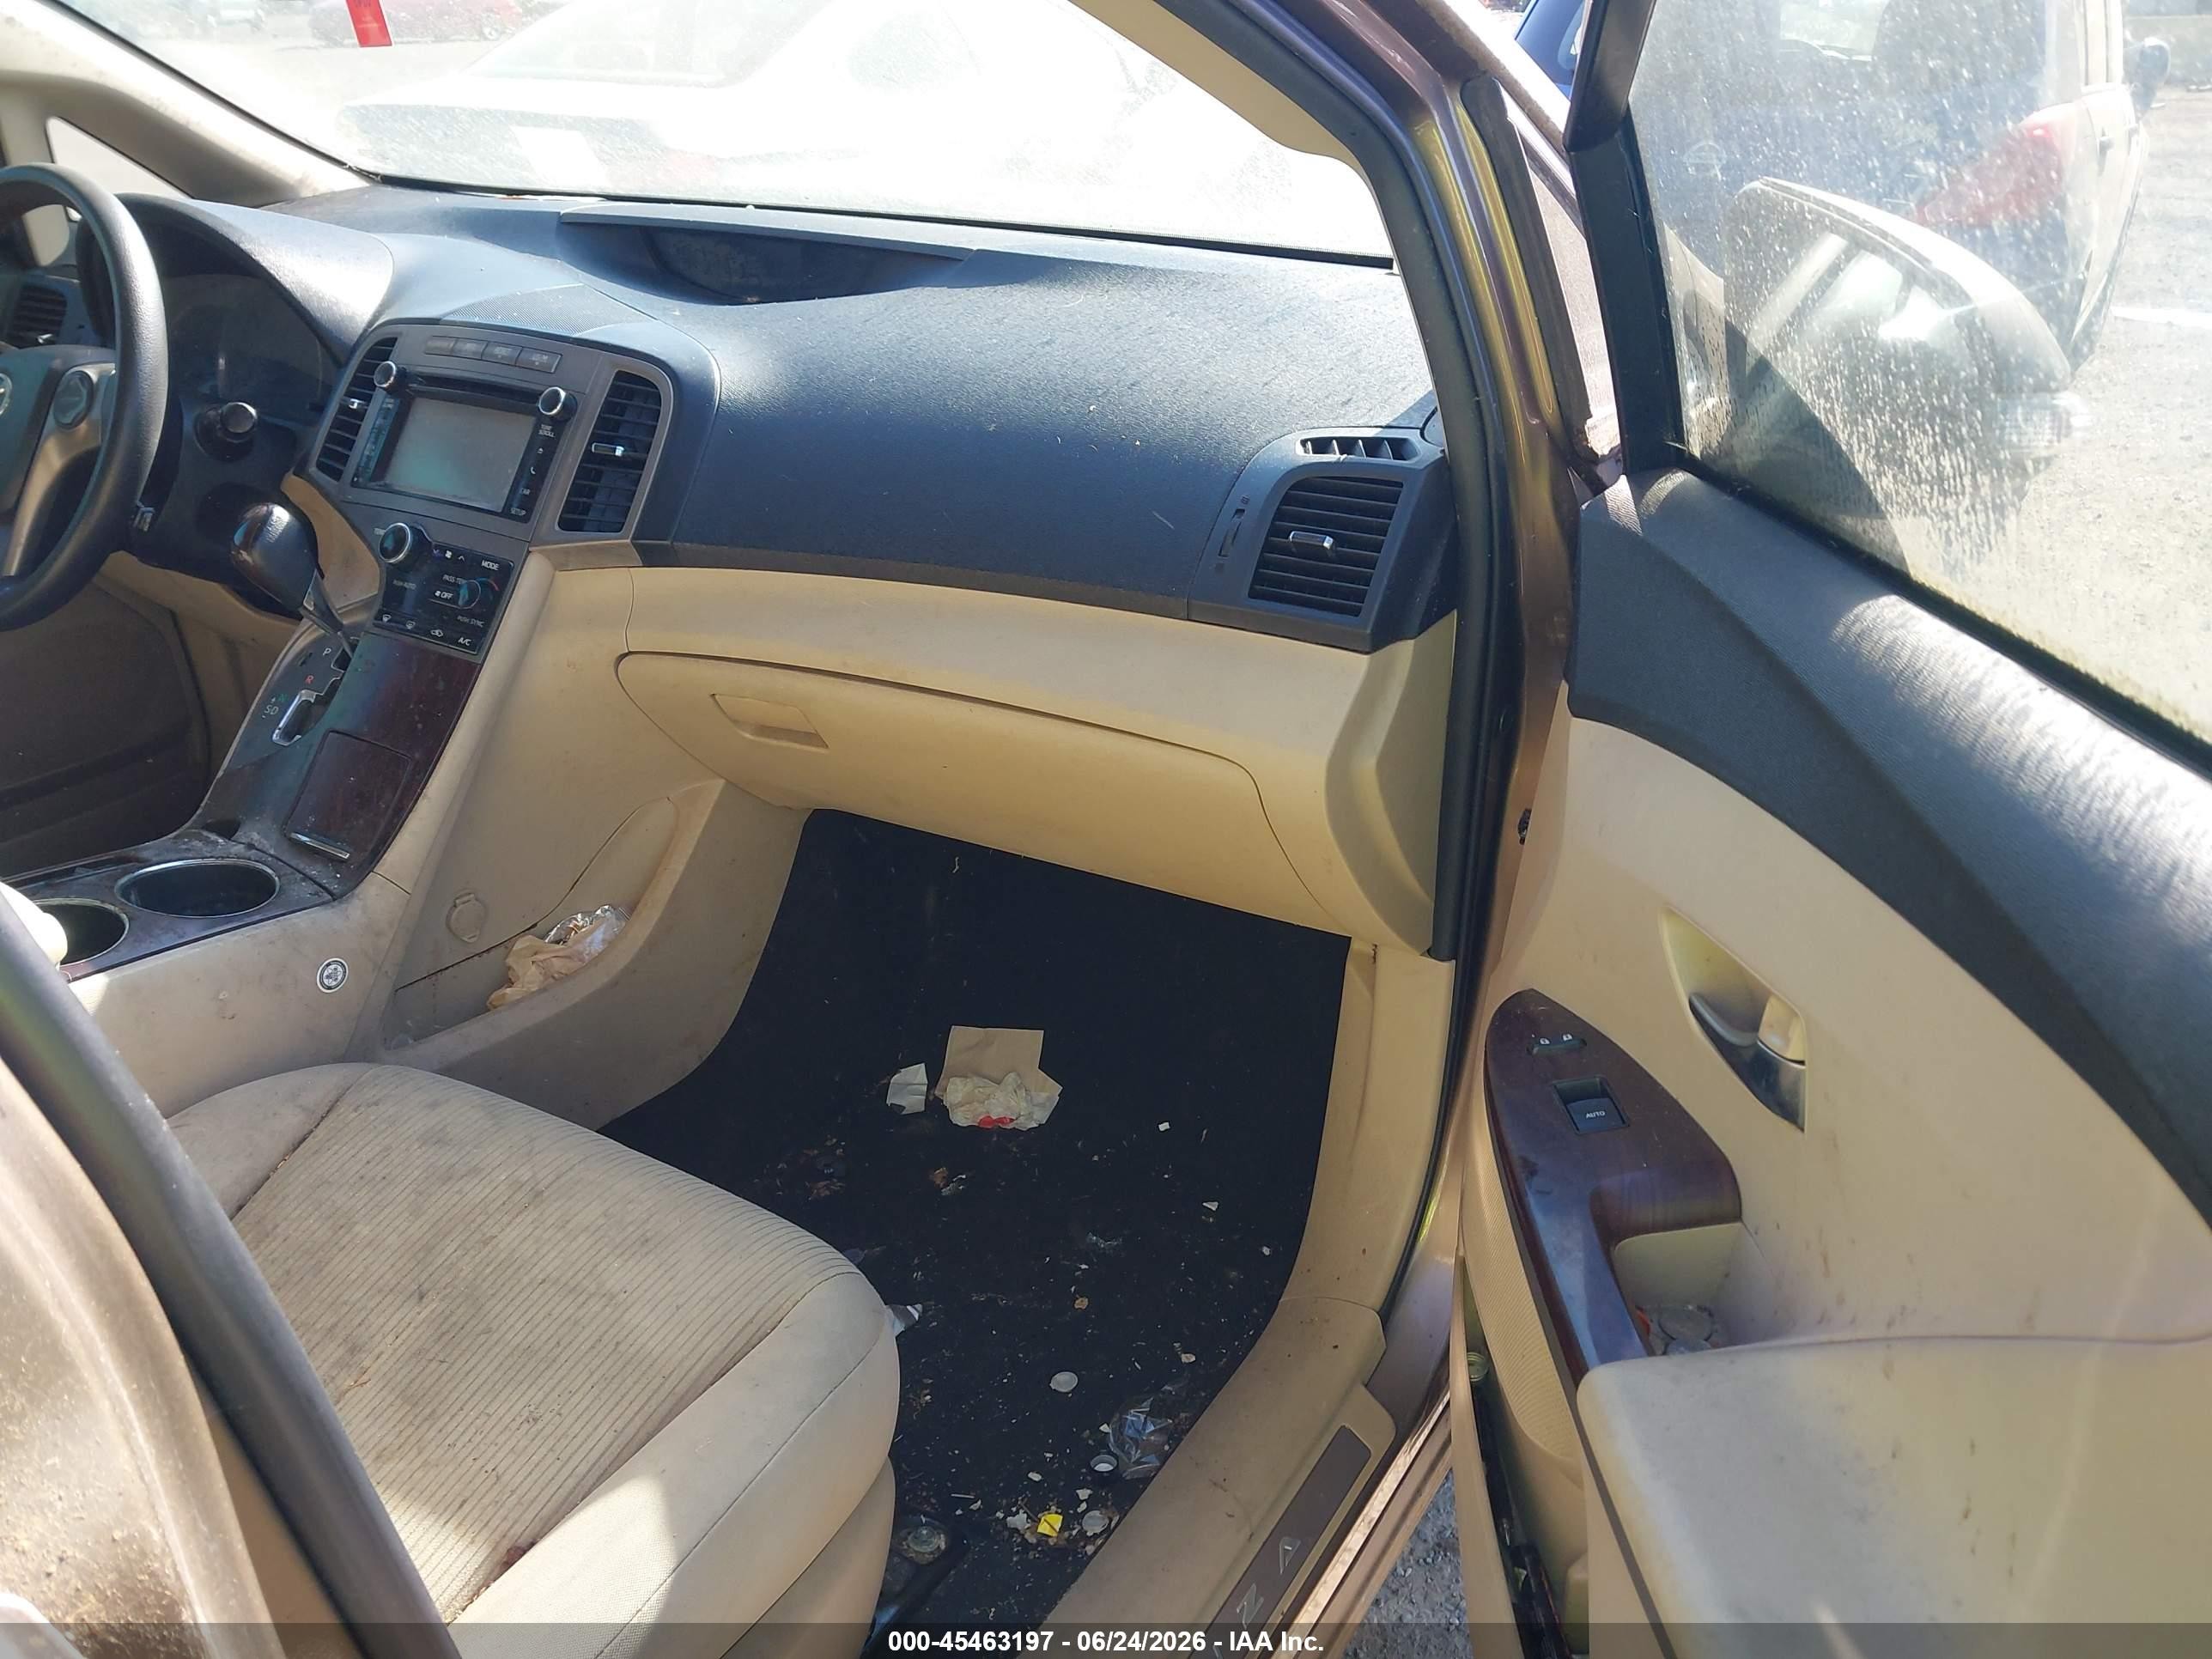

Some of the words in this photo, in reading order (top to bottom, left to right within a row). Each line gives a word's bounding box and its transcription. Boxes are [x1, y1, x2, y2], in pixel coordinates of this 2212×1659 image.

[481, 560, 501, 571] MODE
[441, 591, 453, 599] OFF
[458, 637, 471, 646] A/C
[323, 647, 332, 656] P
[305, 675, 314, 684] R
[1585, 1110, 1606, 1119] AUTO
